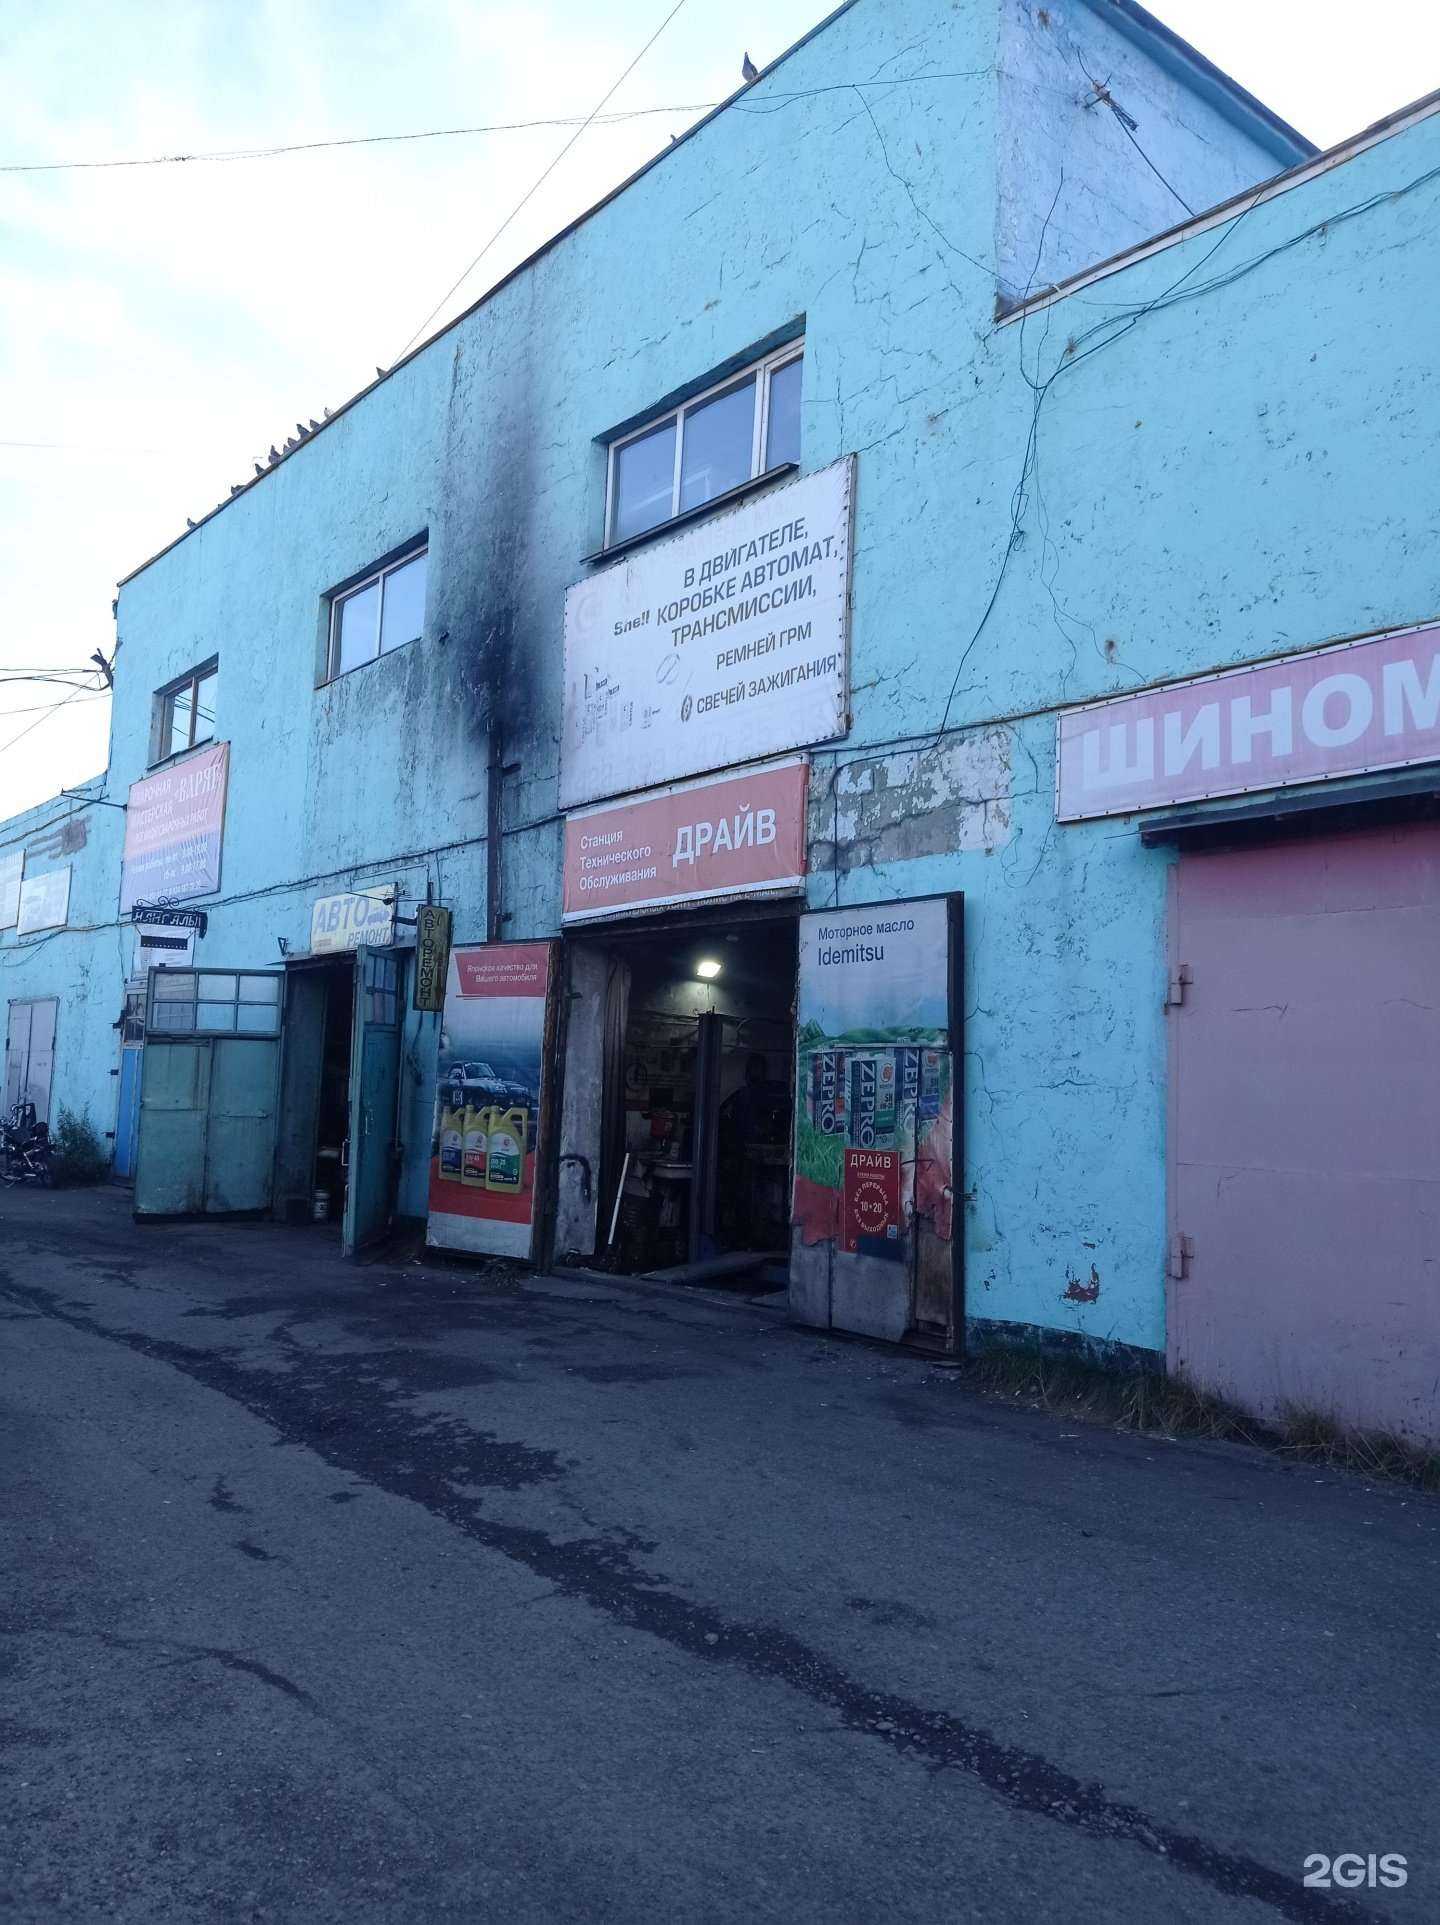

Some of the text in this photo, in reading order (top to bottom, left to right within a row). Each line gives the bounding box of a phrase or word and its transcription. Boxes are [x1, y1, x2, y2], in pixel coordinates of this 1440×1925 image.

[683, 516, 808, 589] В ДВИГАТЕЛЕ,
[656, 535, 838, 626] КОРОБКЕ АВТОМАТ,
[671, 574, 817, 647] ТРАНСМИССИИ,
[716, 621, 812, 670] РЕМНЕЙ ГРМ
[696, 682, 746, 714] СВЕЧЕЙ
[748, 654, 837, 691] ЗАЖИГАНИЯ
[579, 846, 651, 870] Технического
[580, 830, 623, 850] Станция
[672, 802, 777, 868] ДРАЙВ
[579, 866, 657, 891] Обслуживания
[314, 896, 369, 934] АВТО
[347, 927, 390, 947] РЕМОНТ
[818, 919, 915, 941] Моторное масло
[419, 910, 436, 1007] АВТОРЕМОНТ
[818, 943, 885, 966] Idemitsu
[821, 1054, 836, 1133] ZEPRO
[860, 1062, 876, 1149] ZEPRO
[850, 1153, 892, 1169] ДРАЙВ
